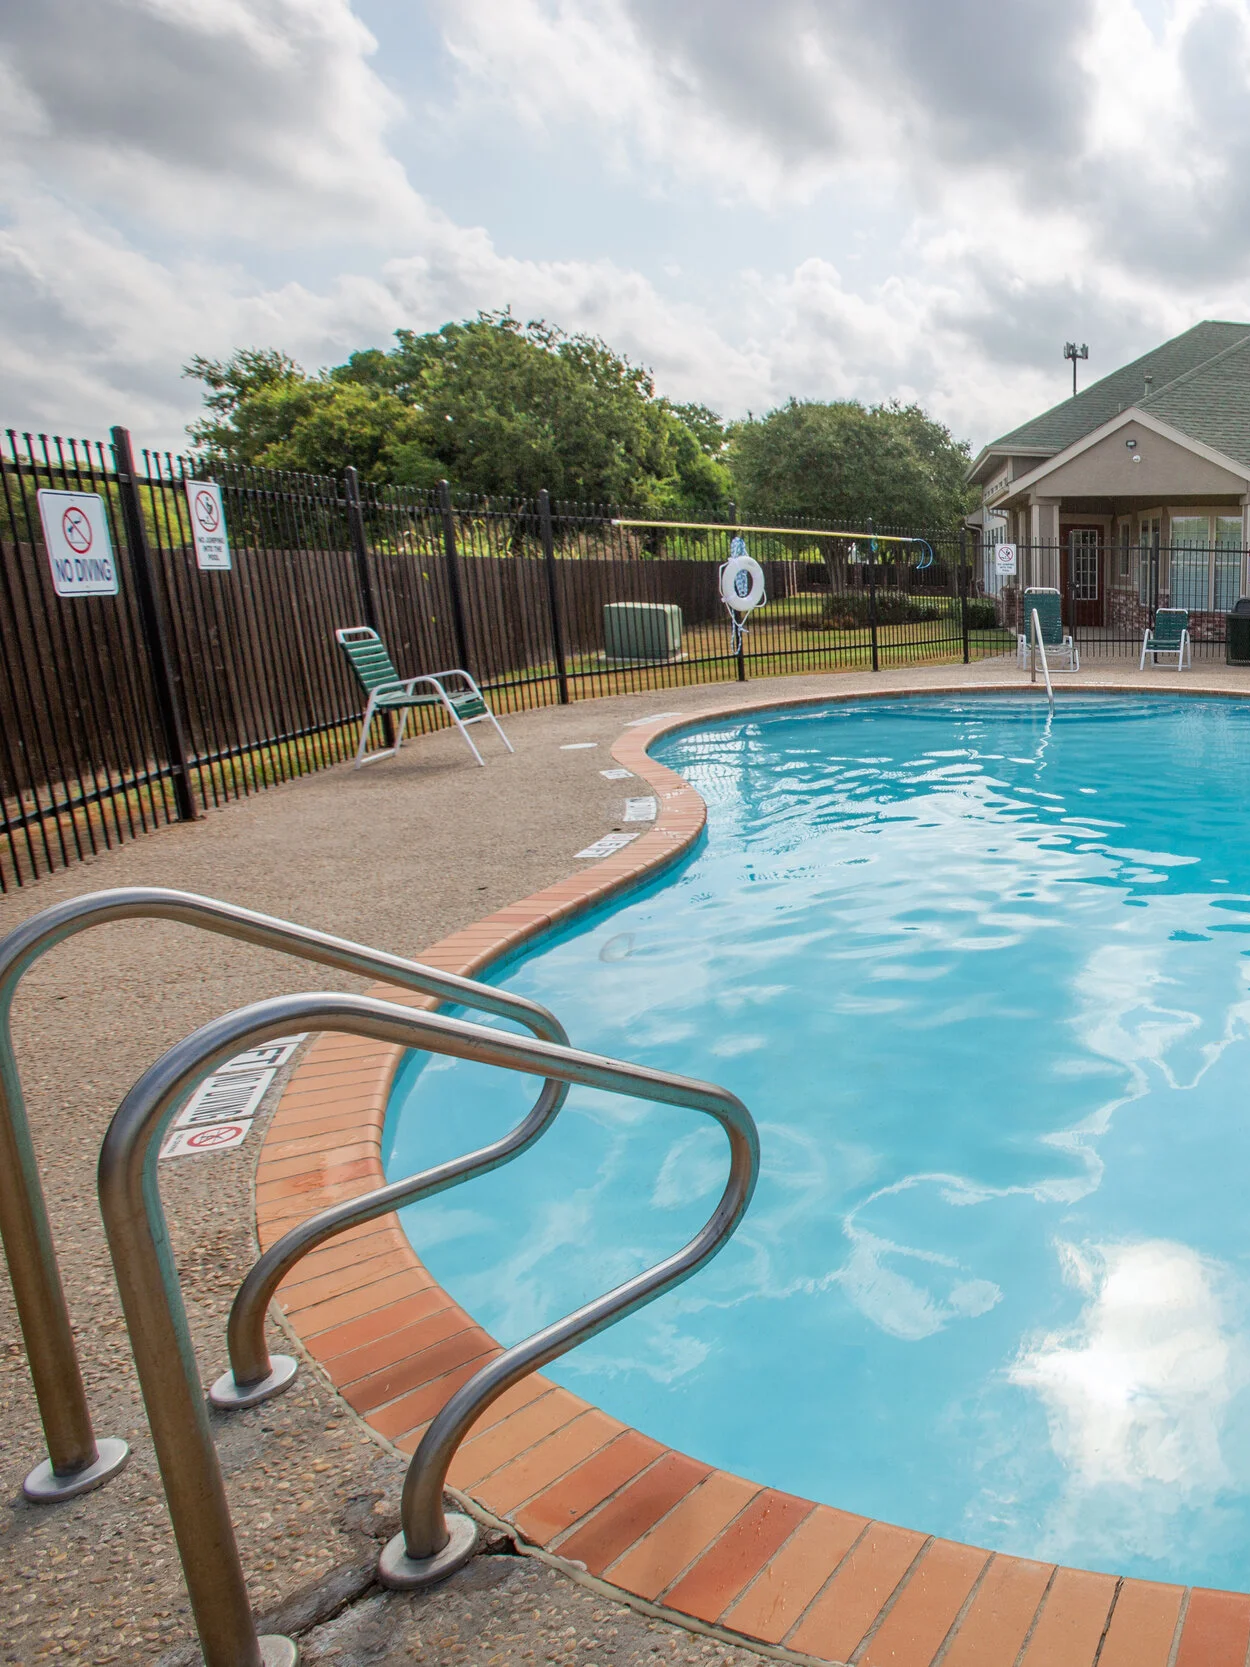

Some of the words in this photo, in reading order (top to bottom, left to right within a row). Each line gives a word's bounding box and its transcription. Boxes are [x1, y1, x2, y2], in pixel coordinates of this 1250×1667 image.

[56, 559, 73, 583] NO
[75, 559, 112, 582] DIVING
[211, 1070, 267, 1088] NO
[189, 1085, 257, 1122] DIVING
